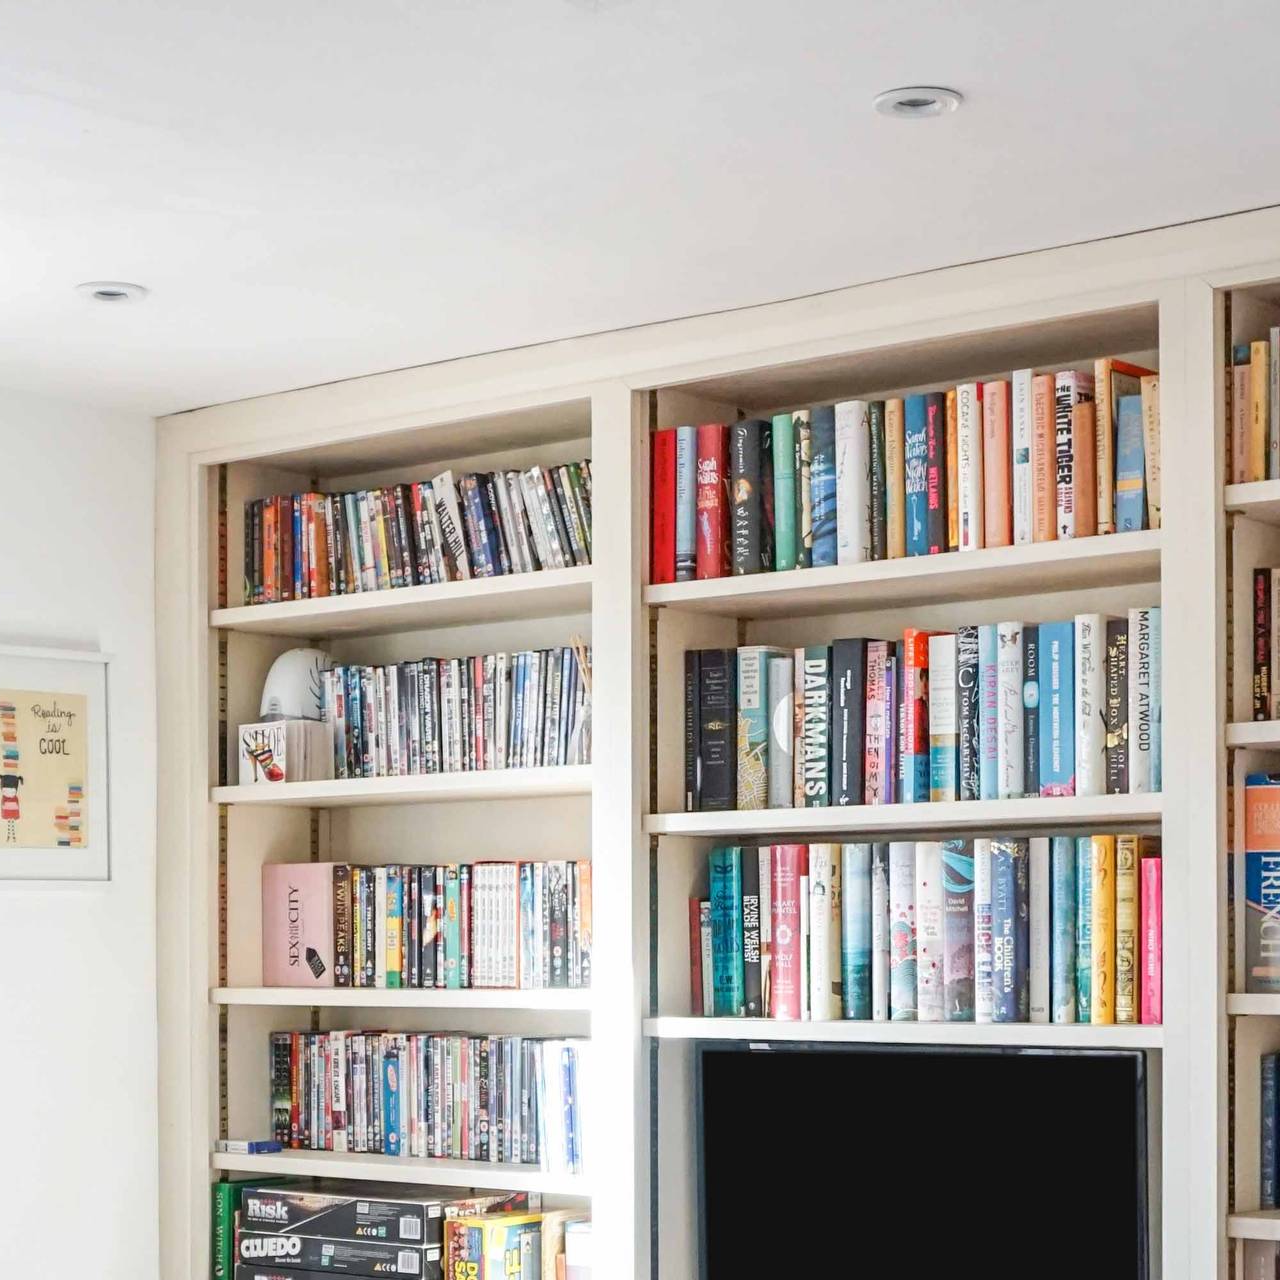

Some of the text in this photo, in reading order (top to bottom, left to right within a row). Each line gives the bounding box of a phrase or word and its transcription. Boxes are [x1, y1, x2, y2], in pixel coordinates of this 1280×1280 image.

[1056, 394, 1073, 485] WHITE TIGER
[961, 690, 970, 714] TOM
[1139, 611, 1150, 752] MARGARET ATWOOD
[31, 701, 76, 726] Reading
[46, 721, 61, 733] is
[804, 660, 826, 796] DARKMANS
[39, 738, 69, 755] COOL
[336, 881, 345, 952] TWIN PEAKS
[750, 895, 759, 962] IRVINE WELSH
[994, 937, 1003, 972] BOOK
[1003, 936, 1013, 993] Children's
[240, 1237, 301, 1258] CLUEDO
